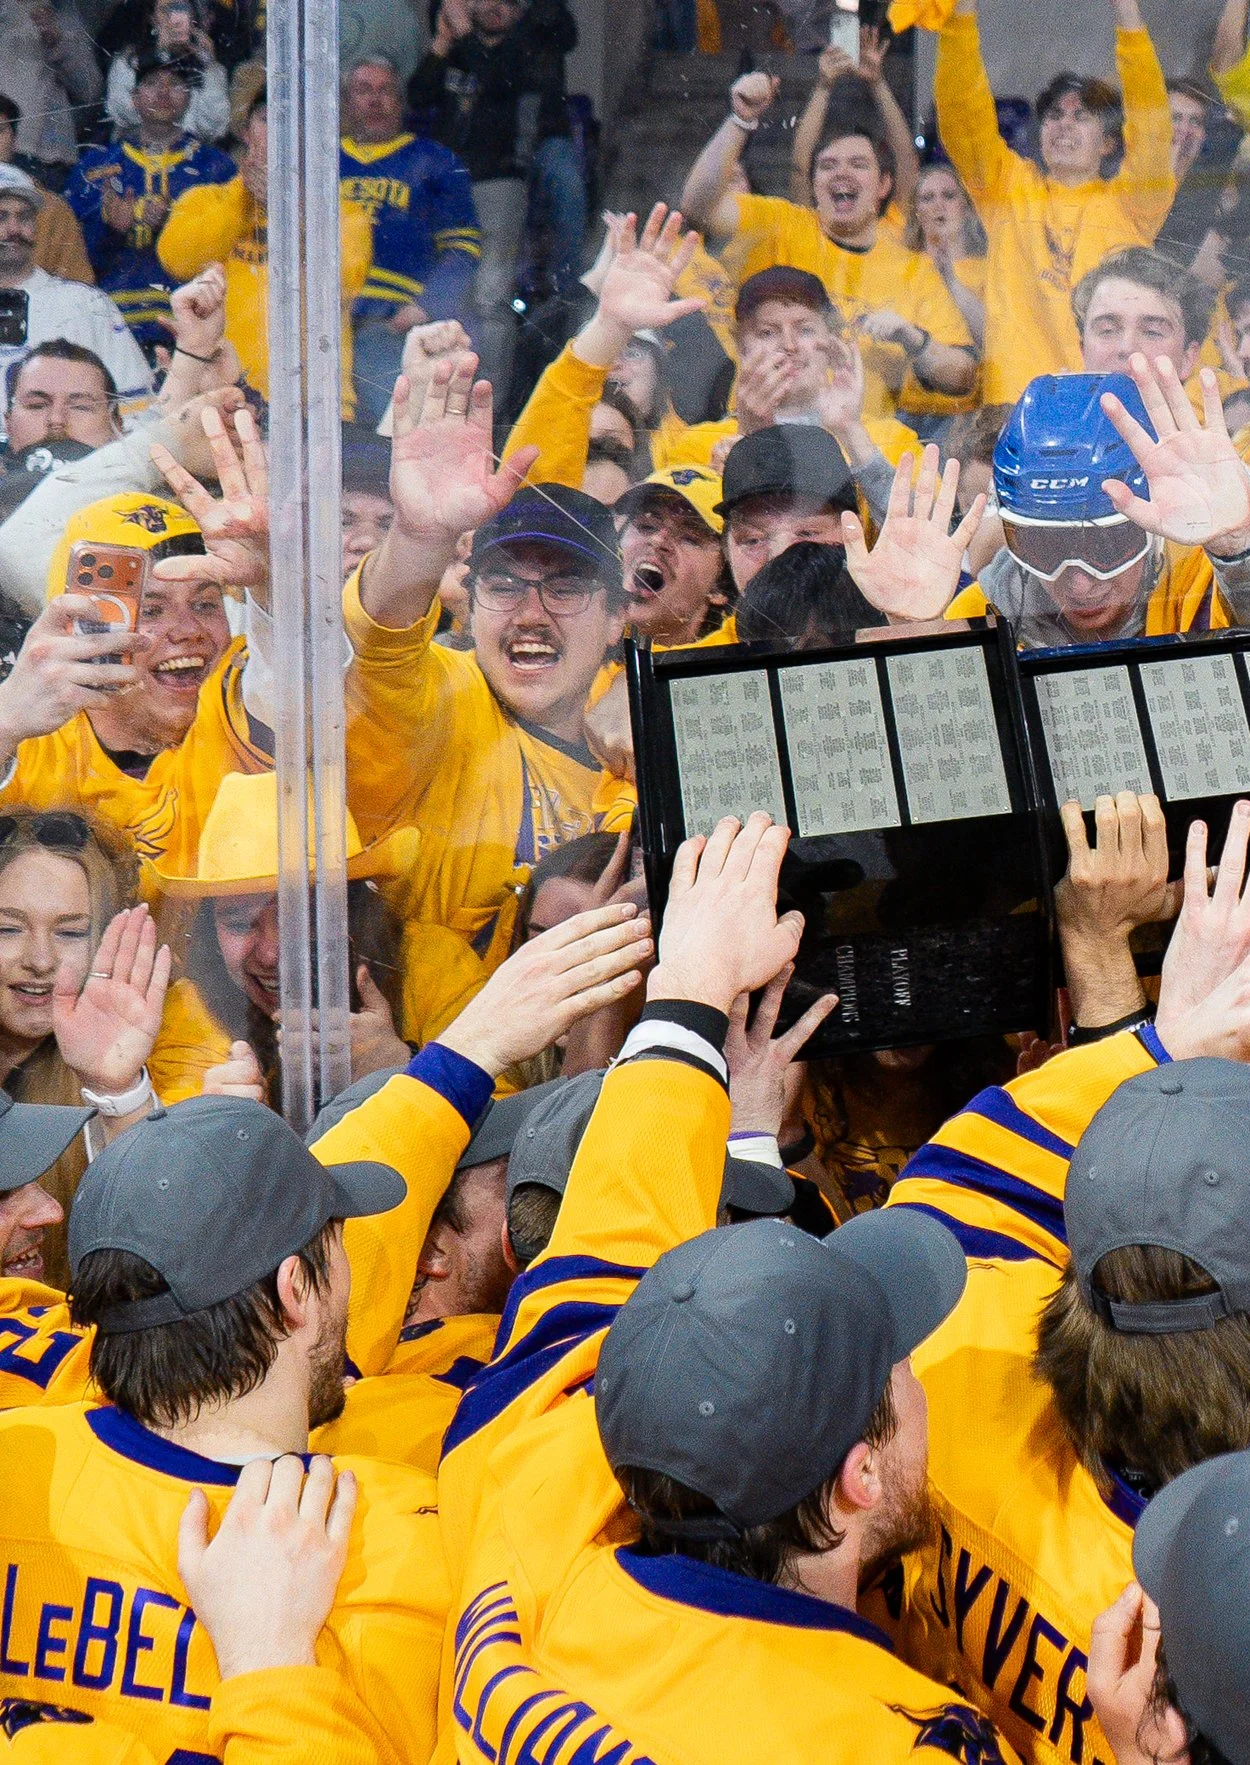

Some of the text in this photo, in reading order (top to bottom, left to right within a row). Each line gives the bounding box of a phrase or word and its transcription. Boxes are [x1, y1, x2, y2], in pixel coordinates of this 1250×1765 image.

[1030, 476, 1089, 489] CCM
[836, 945, 860, 1022] CHAMPIONS
[890, 949, 912, 1006] PLAYOFF
